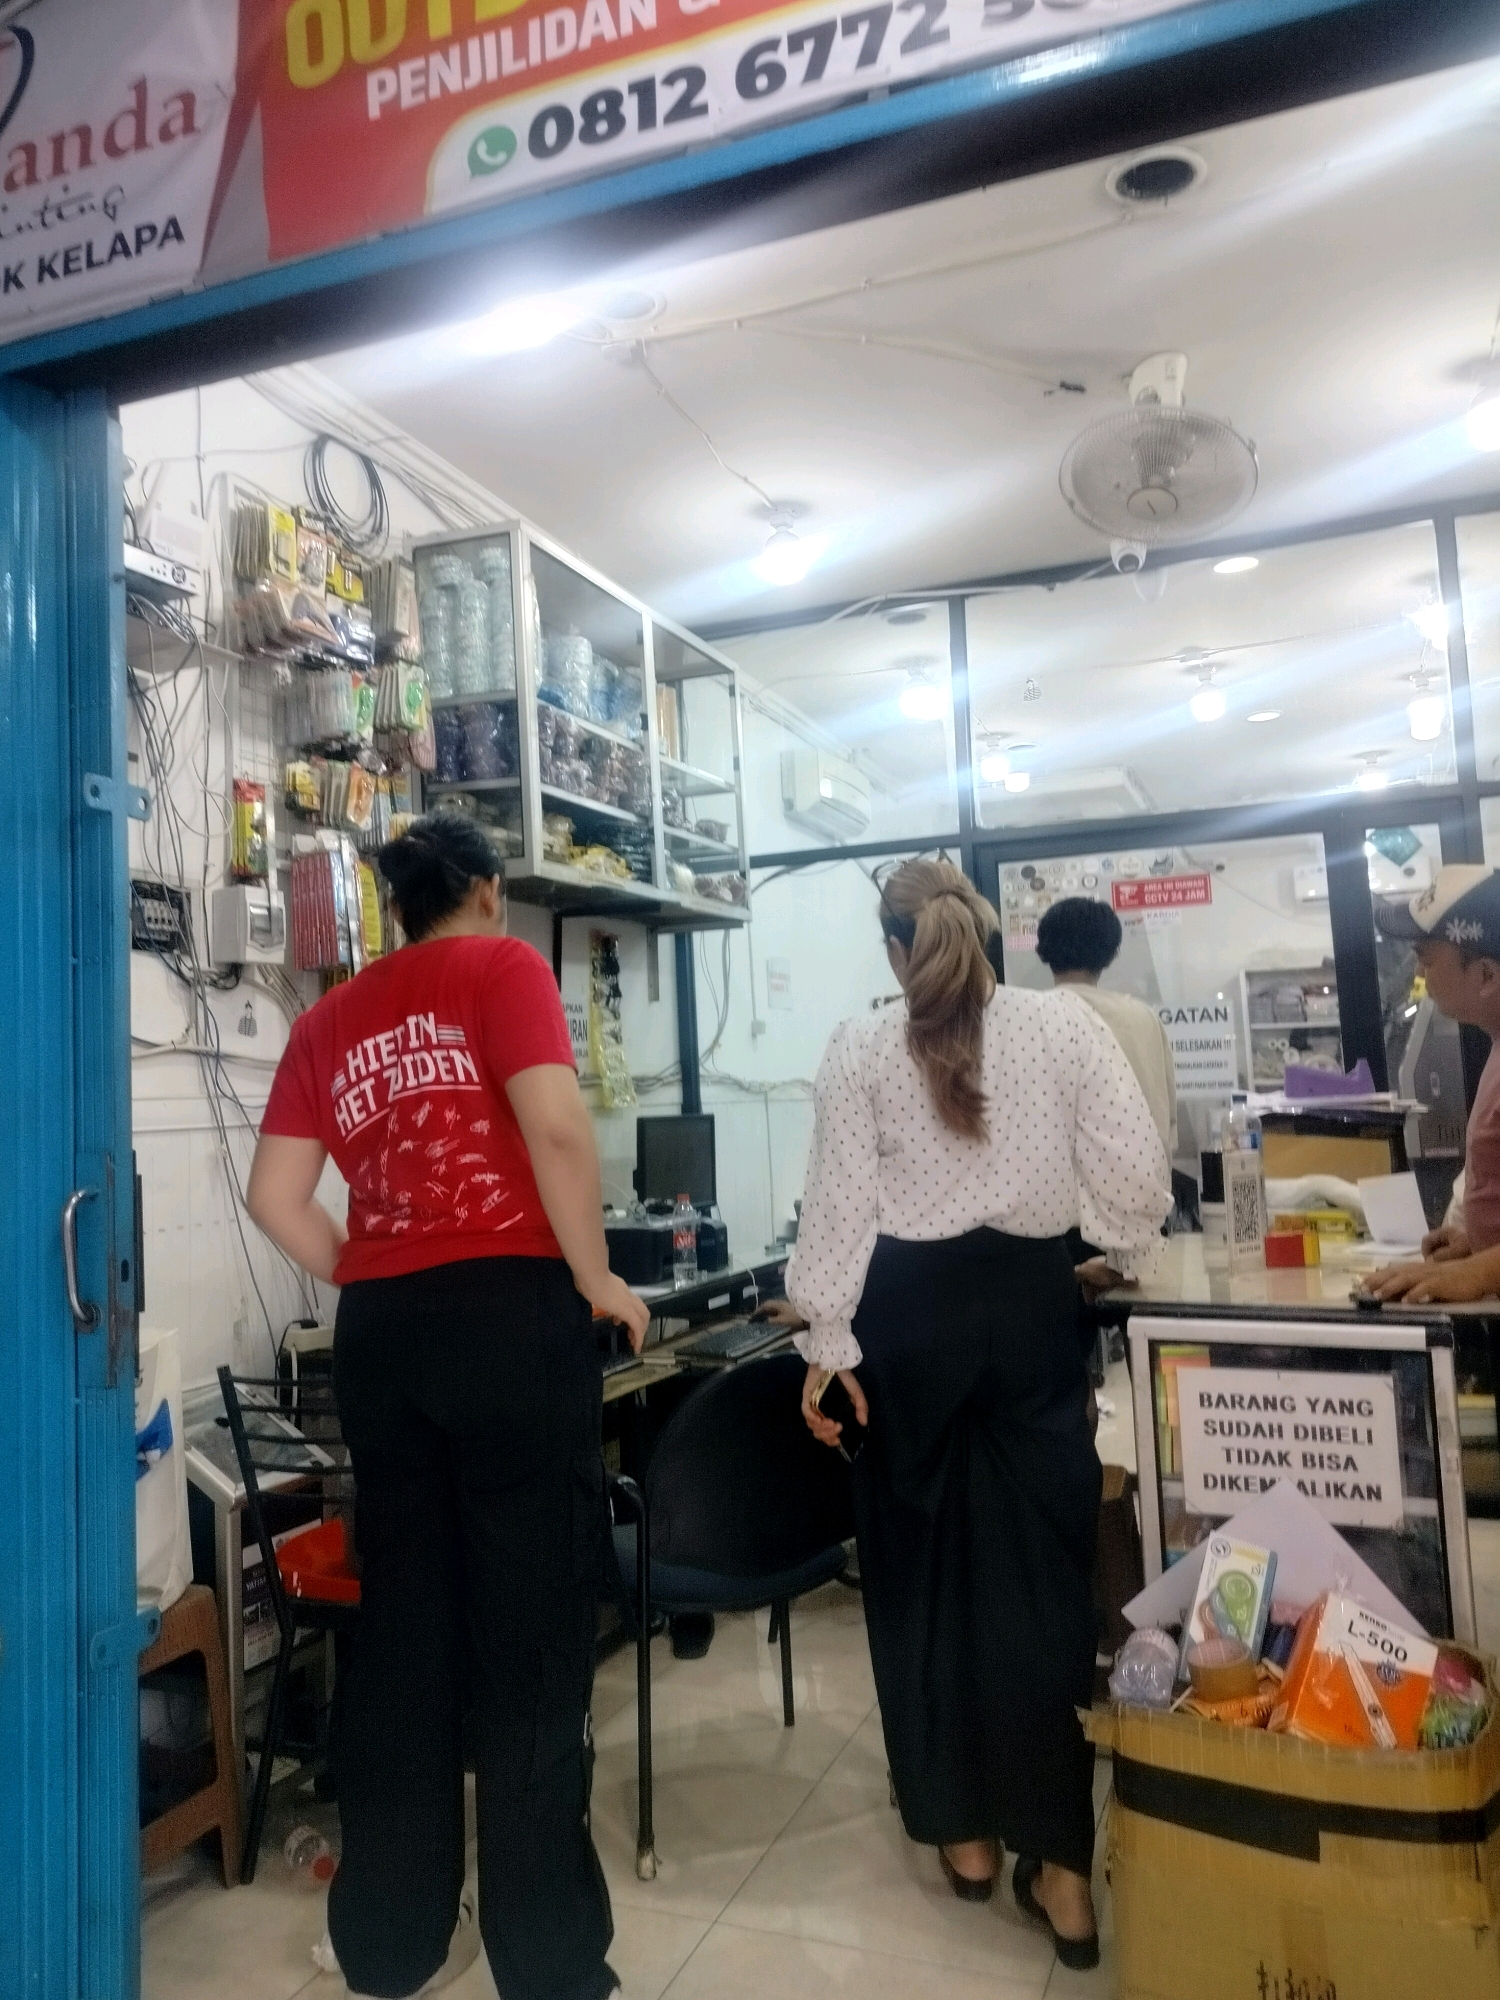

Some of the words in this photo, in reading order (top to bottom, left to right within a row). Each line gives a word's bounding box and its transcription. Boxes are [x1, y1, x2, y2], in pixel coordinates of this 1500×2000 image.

[366, 0, 658, 121] PENJILIDAN
[528, 66, 710, 159] 0812
[735, 0, 950, 101] 6772
[36, 213, 187, 284] KELAPA
[1145, 892, 1169, 904] CCTV
[1171, 890, 1183, 902] 24
[1185, 889, 1206, 900] JAM
[406, 1012, 438, 1049] IN
[1159, 1006, 1228, 1025] GATAN
[1175, 1039, 1222, 1052] SELESAIKAN
[335, 1077, 377, 1137] HET
[1199, 1391, 1297, 1413] BARANG
[1305, 1396, 1374, 1418] YANG
[1203, 1419, 1284, 1440] SUDAH
[1293, 1422, 1374, 1446] DIBELI
[1221, 1446, 1293, 1468] TIDAK
[1302, 1450, 1359, 1473] BISA
[1203, 1472, 1382, 1502] DIKEMALIKAN
[1347, 1618, 1408, 1663] L-500
